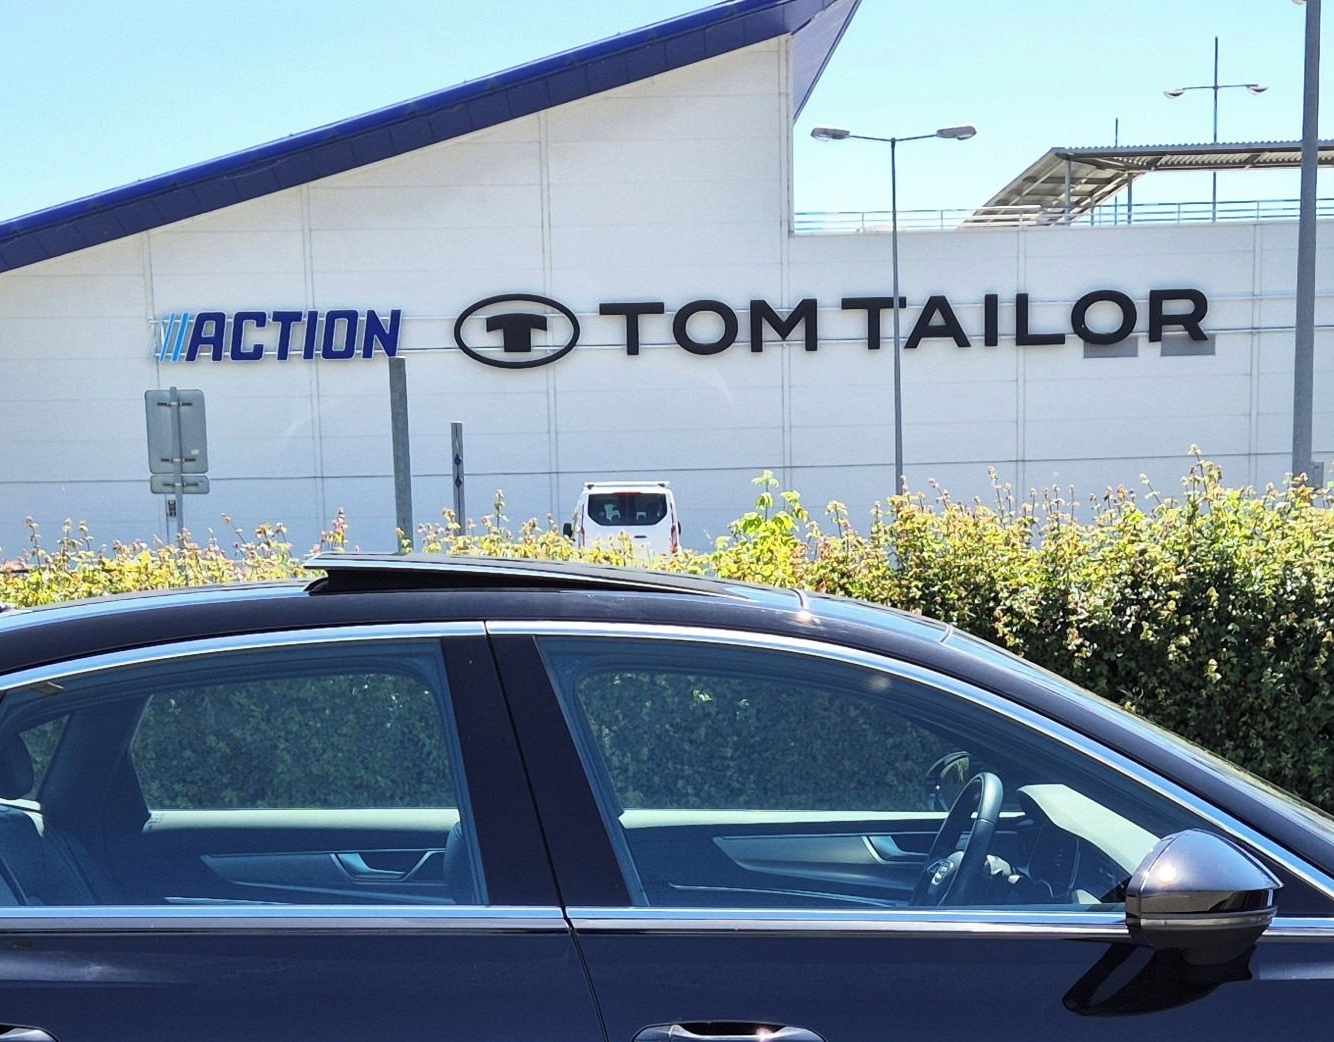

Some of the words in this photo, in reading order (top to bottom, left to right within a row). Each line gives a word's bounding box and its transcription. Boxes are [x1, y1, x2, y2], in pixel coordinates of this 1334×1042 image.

[184, 308, 403, 362] ACTION
[599, 298, 818, 355] TOM
[841, 288, 1208, 350] TAILOR
